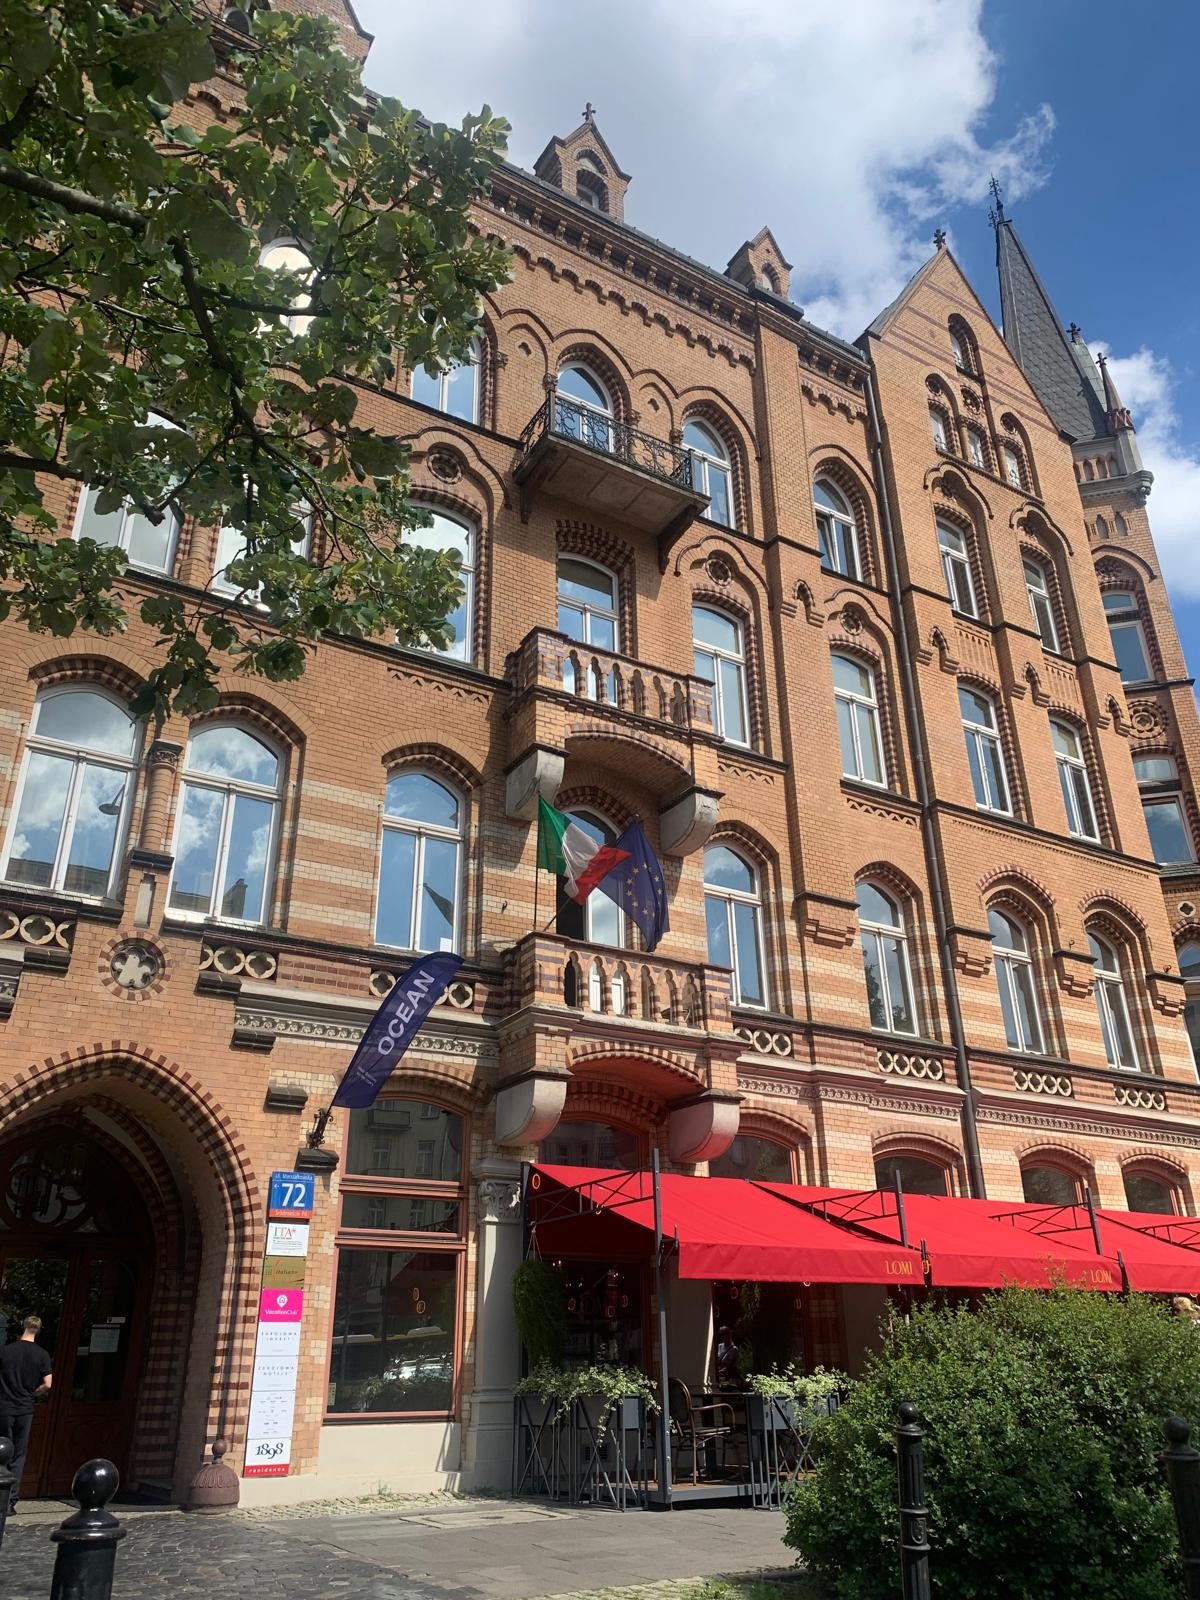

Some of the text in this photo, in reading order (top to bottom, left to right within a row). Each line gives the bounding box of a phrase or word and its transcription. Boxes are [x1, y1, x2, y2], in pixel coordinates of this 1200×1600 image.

[377, 969, 436, 1056] OCEAN
[281, 1183, 306, 1208] 72
[885, 1260, 913, 1275] LOMI
[255, 1442, 284, 1460] 1898
